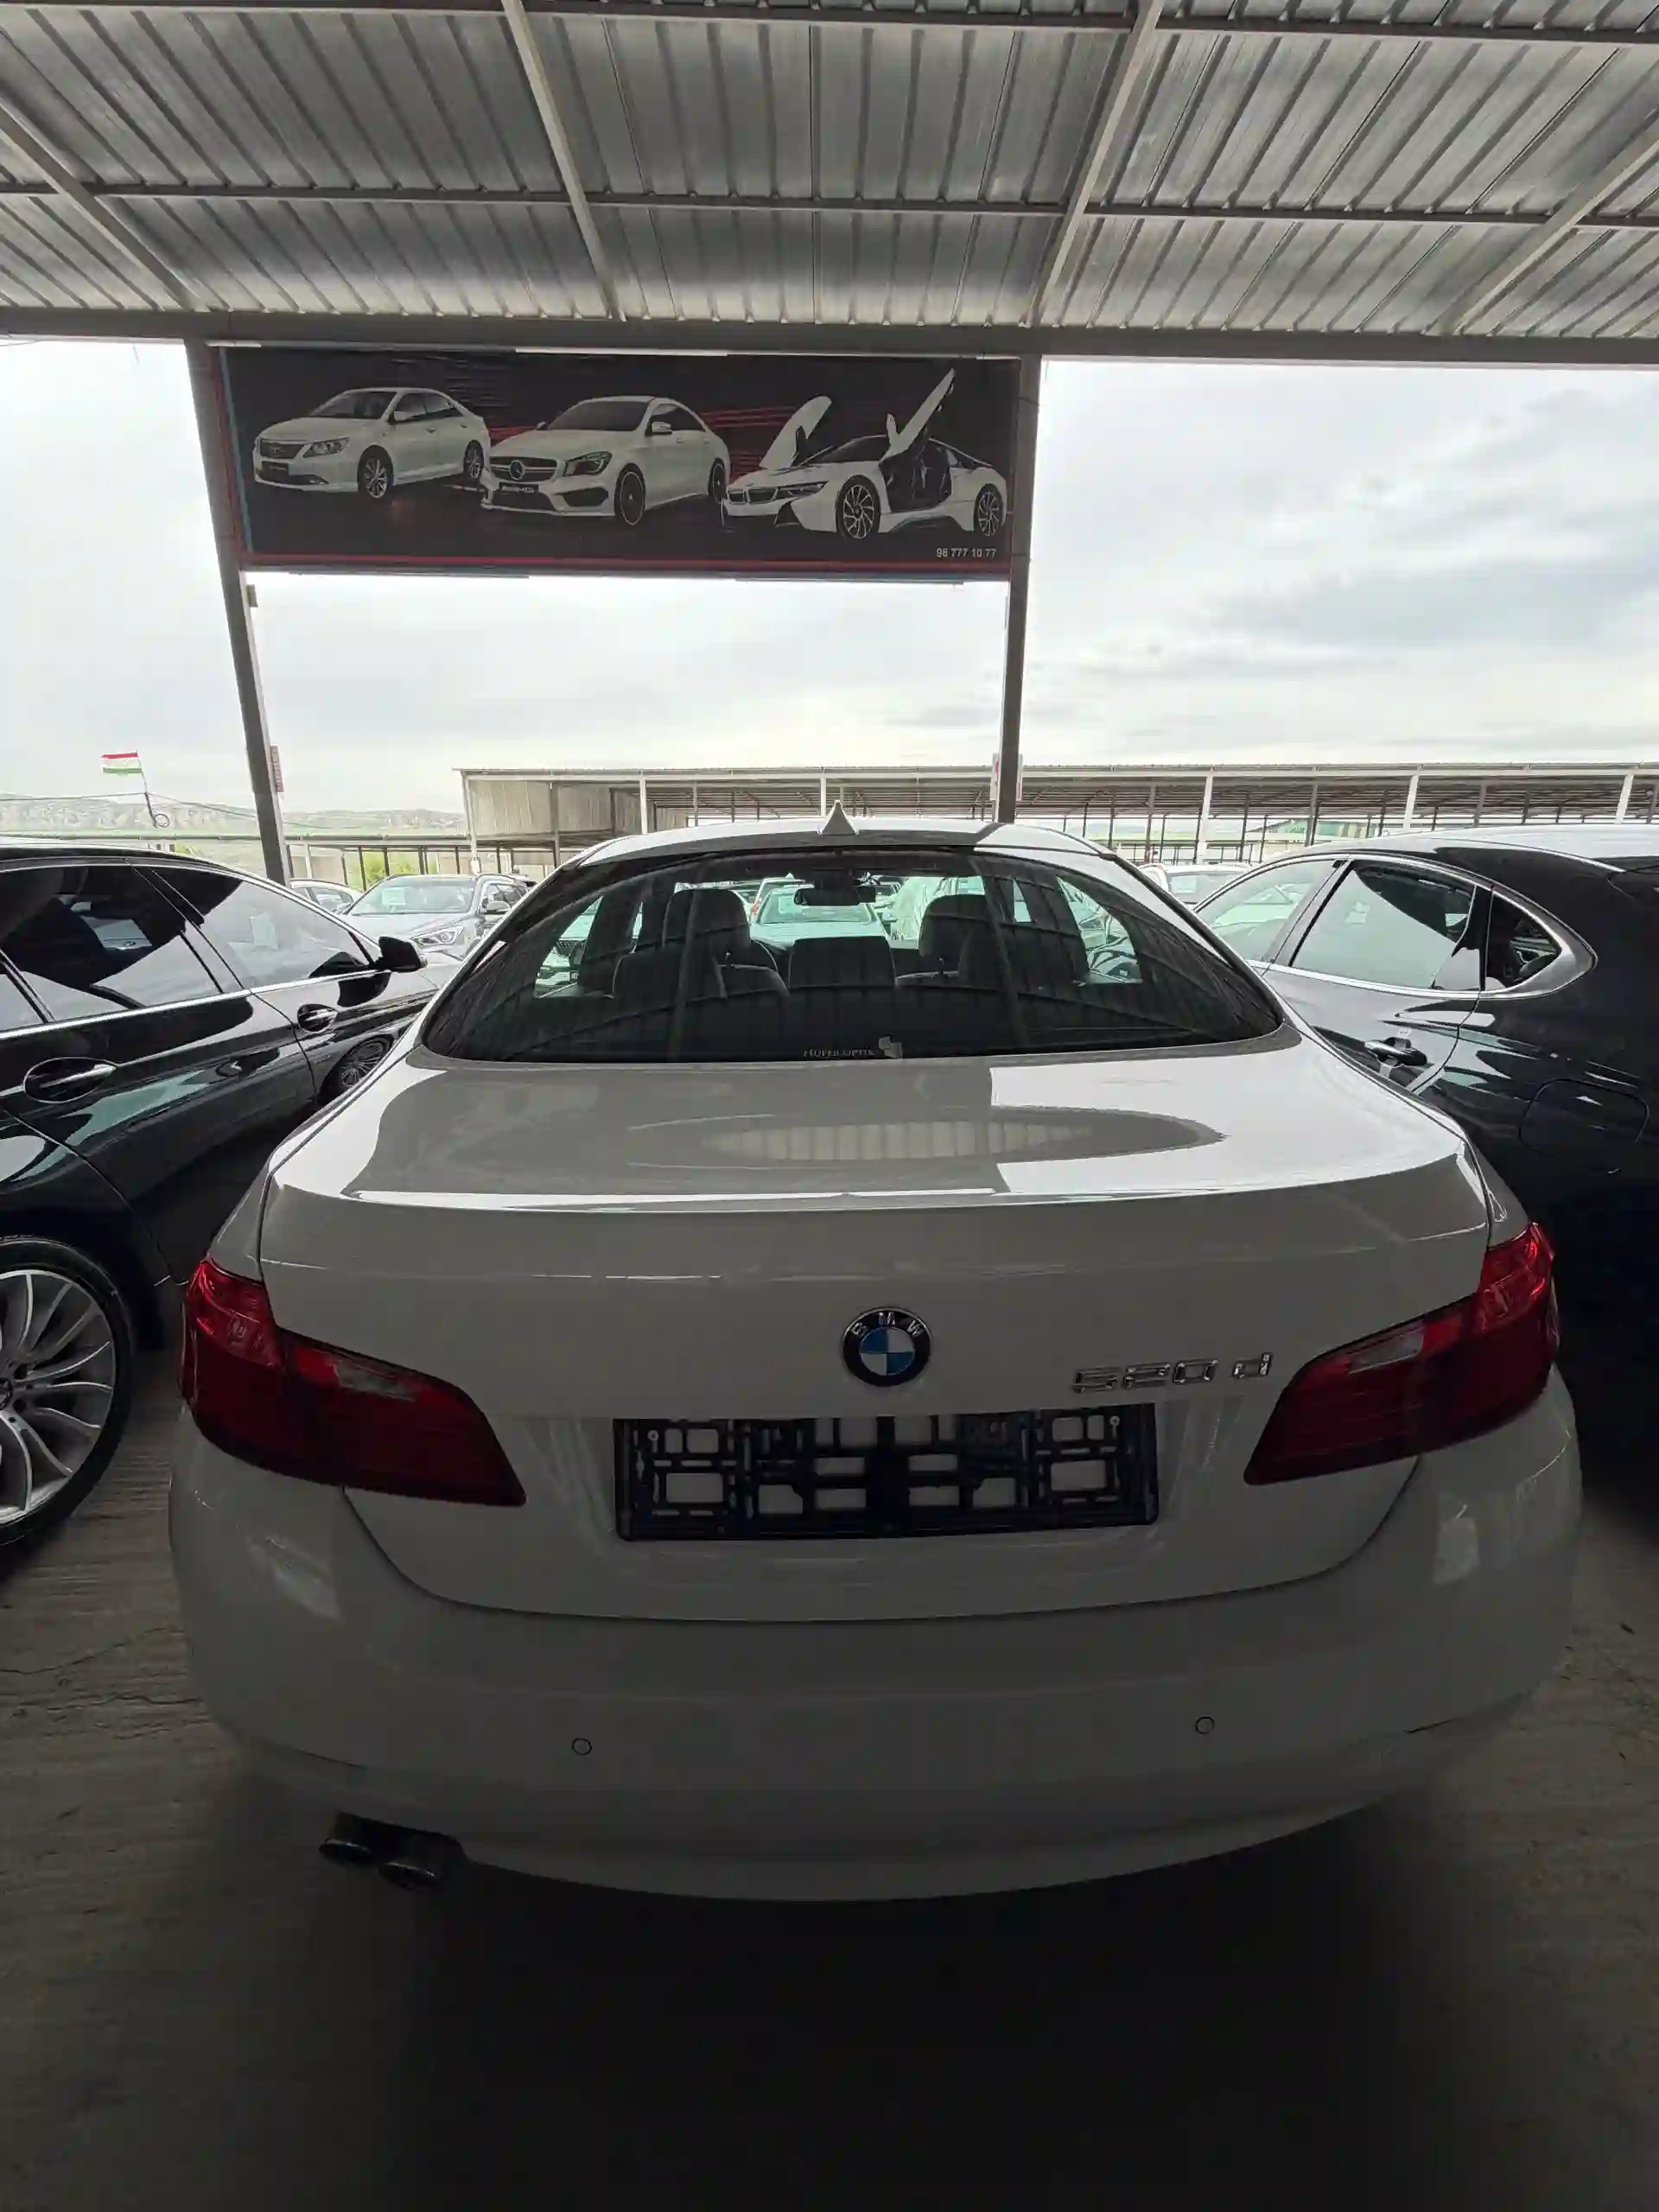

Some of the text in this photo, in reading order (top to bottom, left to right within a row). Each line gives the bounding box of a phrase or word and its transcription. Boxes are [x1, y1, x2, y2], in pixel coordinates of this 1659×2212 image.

[950, 547, 968, 557] 777
[971, 547, 982, 558] 10
[985, 547, 996, 560] 77
[852, 1311, 924, 1338] BMW
